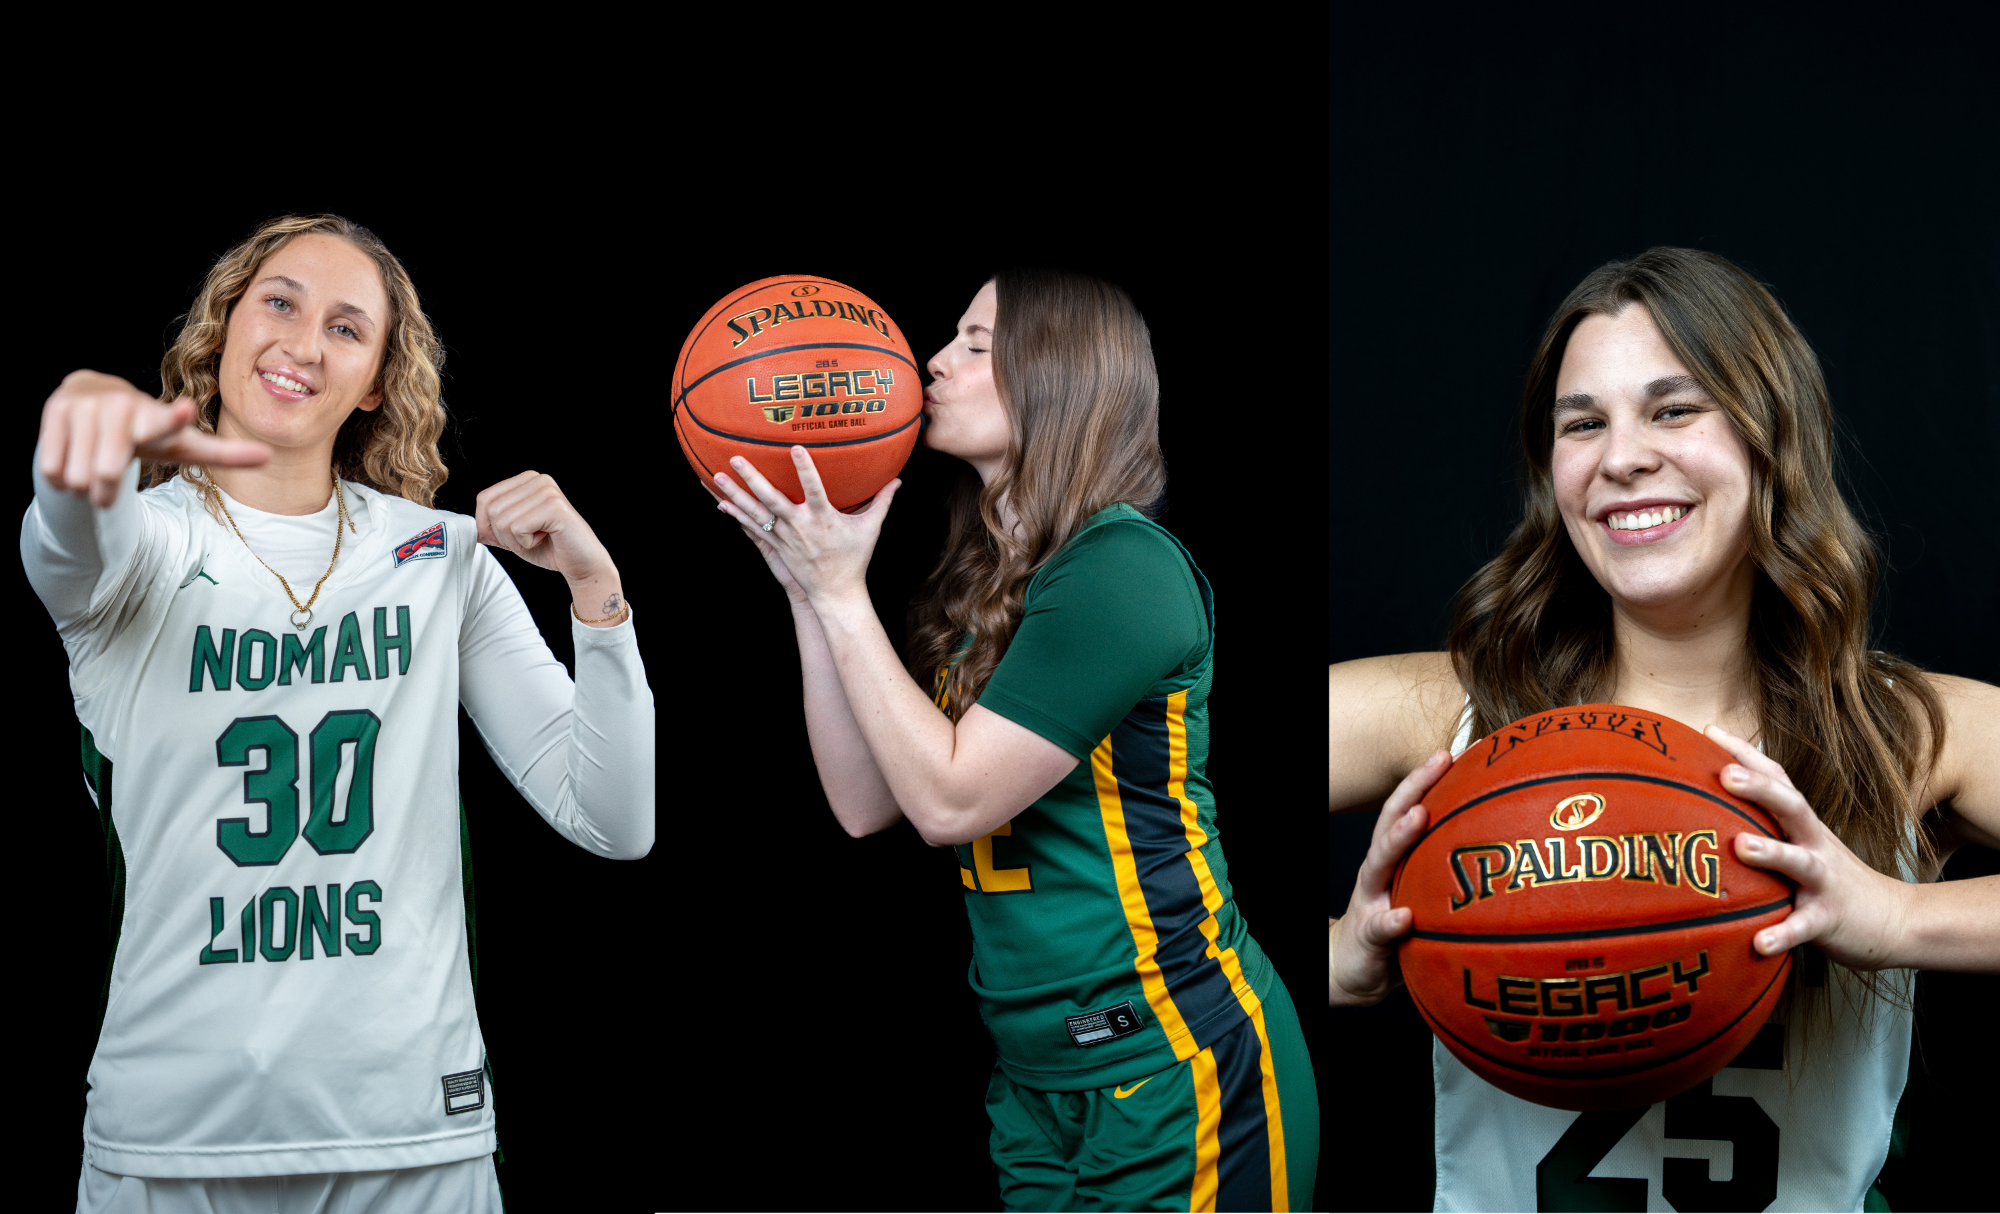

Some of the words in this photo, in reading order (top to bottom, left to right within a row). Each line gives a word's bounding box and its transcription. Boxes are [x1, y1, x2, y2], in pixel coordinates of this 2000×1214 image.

[726, 300, 892, 349] SPALDING
[815, 360, 839, 369] 28.5
[747, 369, 895, 404] LEGACY
[791, 420, 826, 432] OFFICIAL
[828, 419, 848, 429] GAME
[850, 418, 866, 427] BALL
[800, 399, 886, 418] 1000
[189, 605, 411, 693] NOMAH
[215, 709, 382, 868] 30
[1448, 830, 1720, 913] SPALDING
[199, 879, 383, 965] LIONS
[1462, 949, 1711, 1018] LEGACY
[1565, 956, 1605, 972] 28.5
[1117, 1015, 1130, 1028] S
[1539, 1003, 1693, 1043] 1000
[1527, 1046, 1581, 1059] OFFICIAL
[1586, 1044, 1619, 1057] GAME
[1625, 1038, 1654, 1053] BALL
[1536, 1022, 1784, 1213] 25
